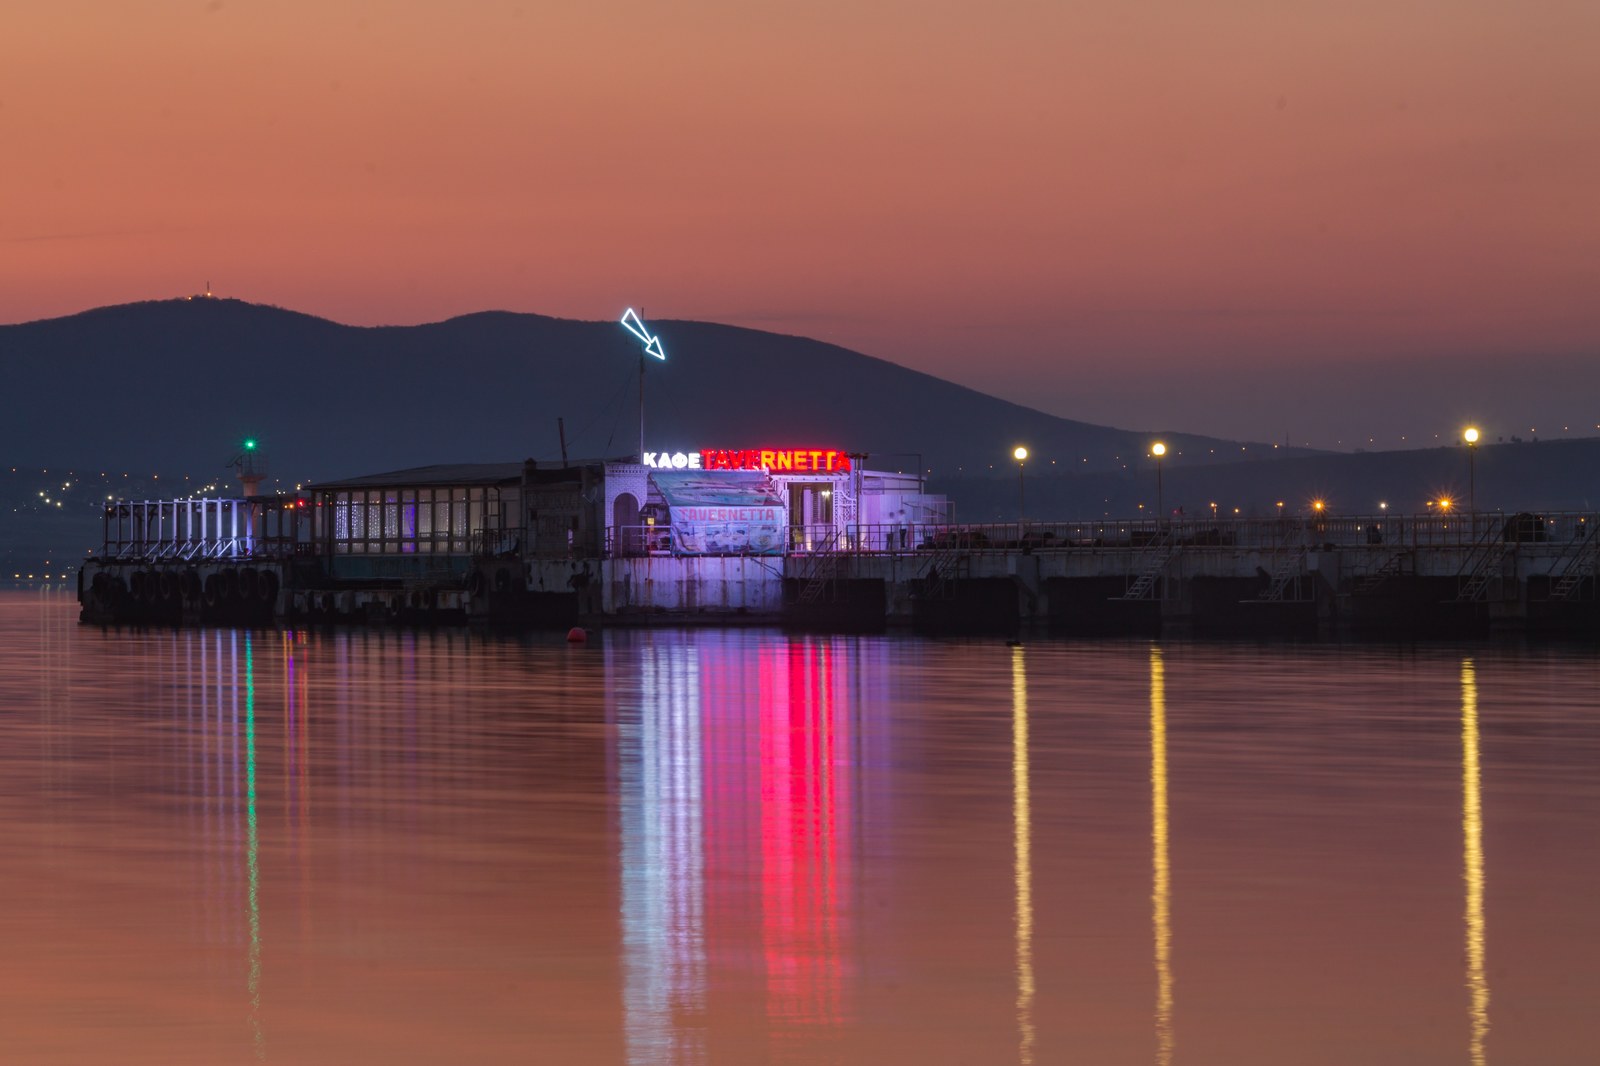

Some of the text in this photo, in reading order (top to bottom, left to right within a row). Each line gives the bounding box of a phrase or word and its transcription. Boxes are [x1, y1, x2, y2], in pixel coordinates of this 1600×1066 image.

[643, 450, 850, 470] КАФЕ TAVERNETTA
[678, 508, 774, 521] TAVERNETTA
